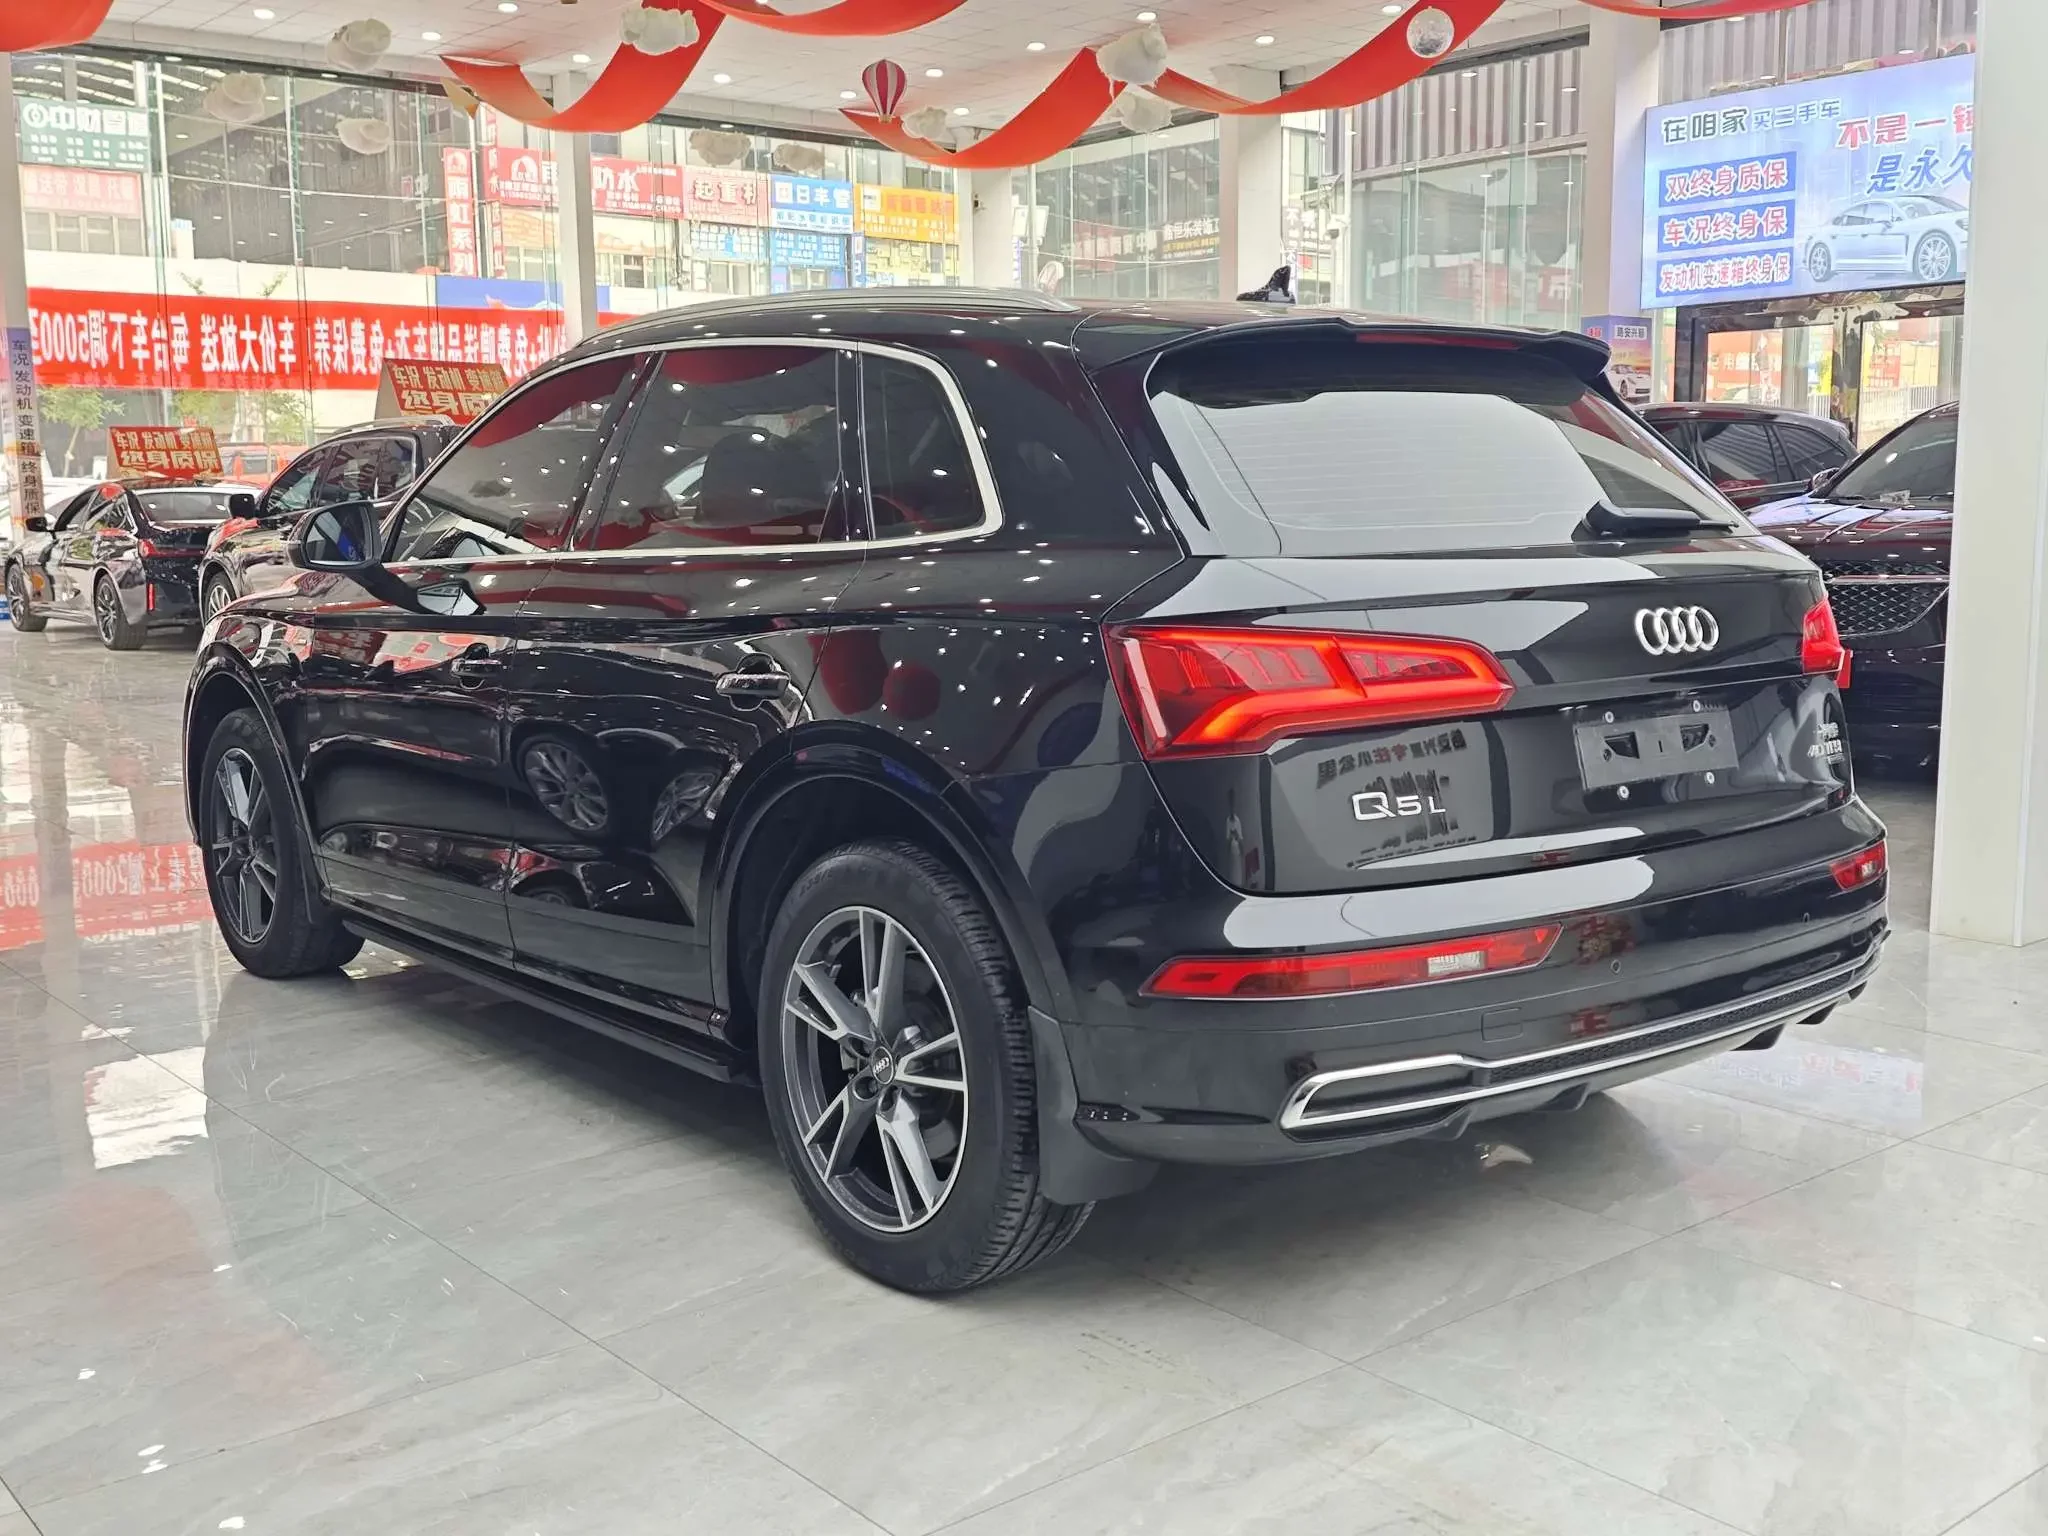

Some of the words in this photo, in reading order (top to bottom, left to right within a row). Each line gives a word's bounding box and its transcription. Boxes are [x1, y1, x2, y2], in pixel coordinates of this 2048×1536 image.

[1663, 107, 1748, 144] 在咱家
[1752, 98, 1841, 128] 买二手车
[1666, 157, 1788, 201] 双终身质保
[1664, 205, 1787, 246] 车况终身保
[1660, 254, 1791, 293] 发动机变速箱终身保
[393, 364, 422, 388] 车况
[402, 390, 500, 418] 终身质
[115, 431, 139, 450] 车况
[119, 449, 220, 471] 终身质保
